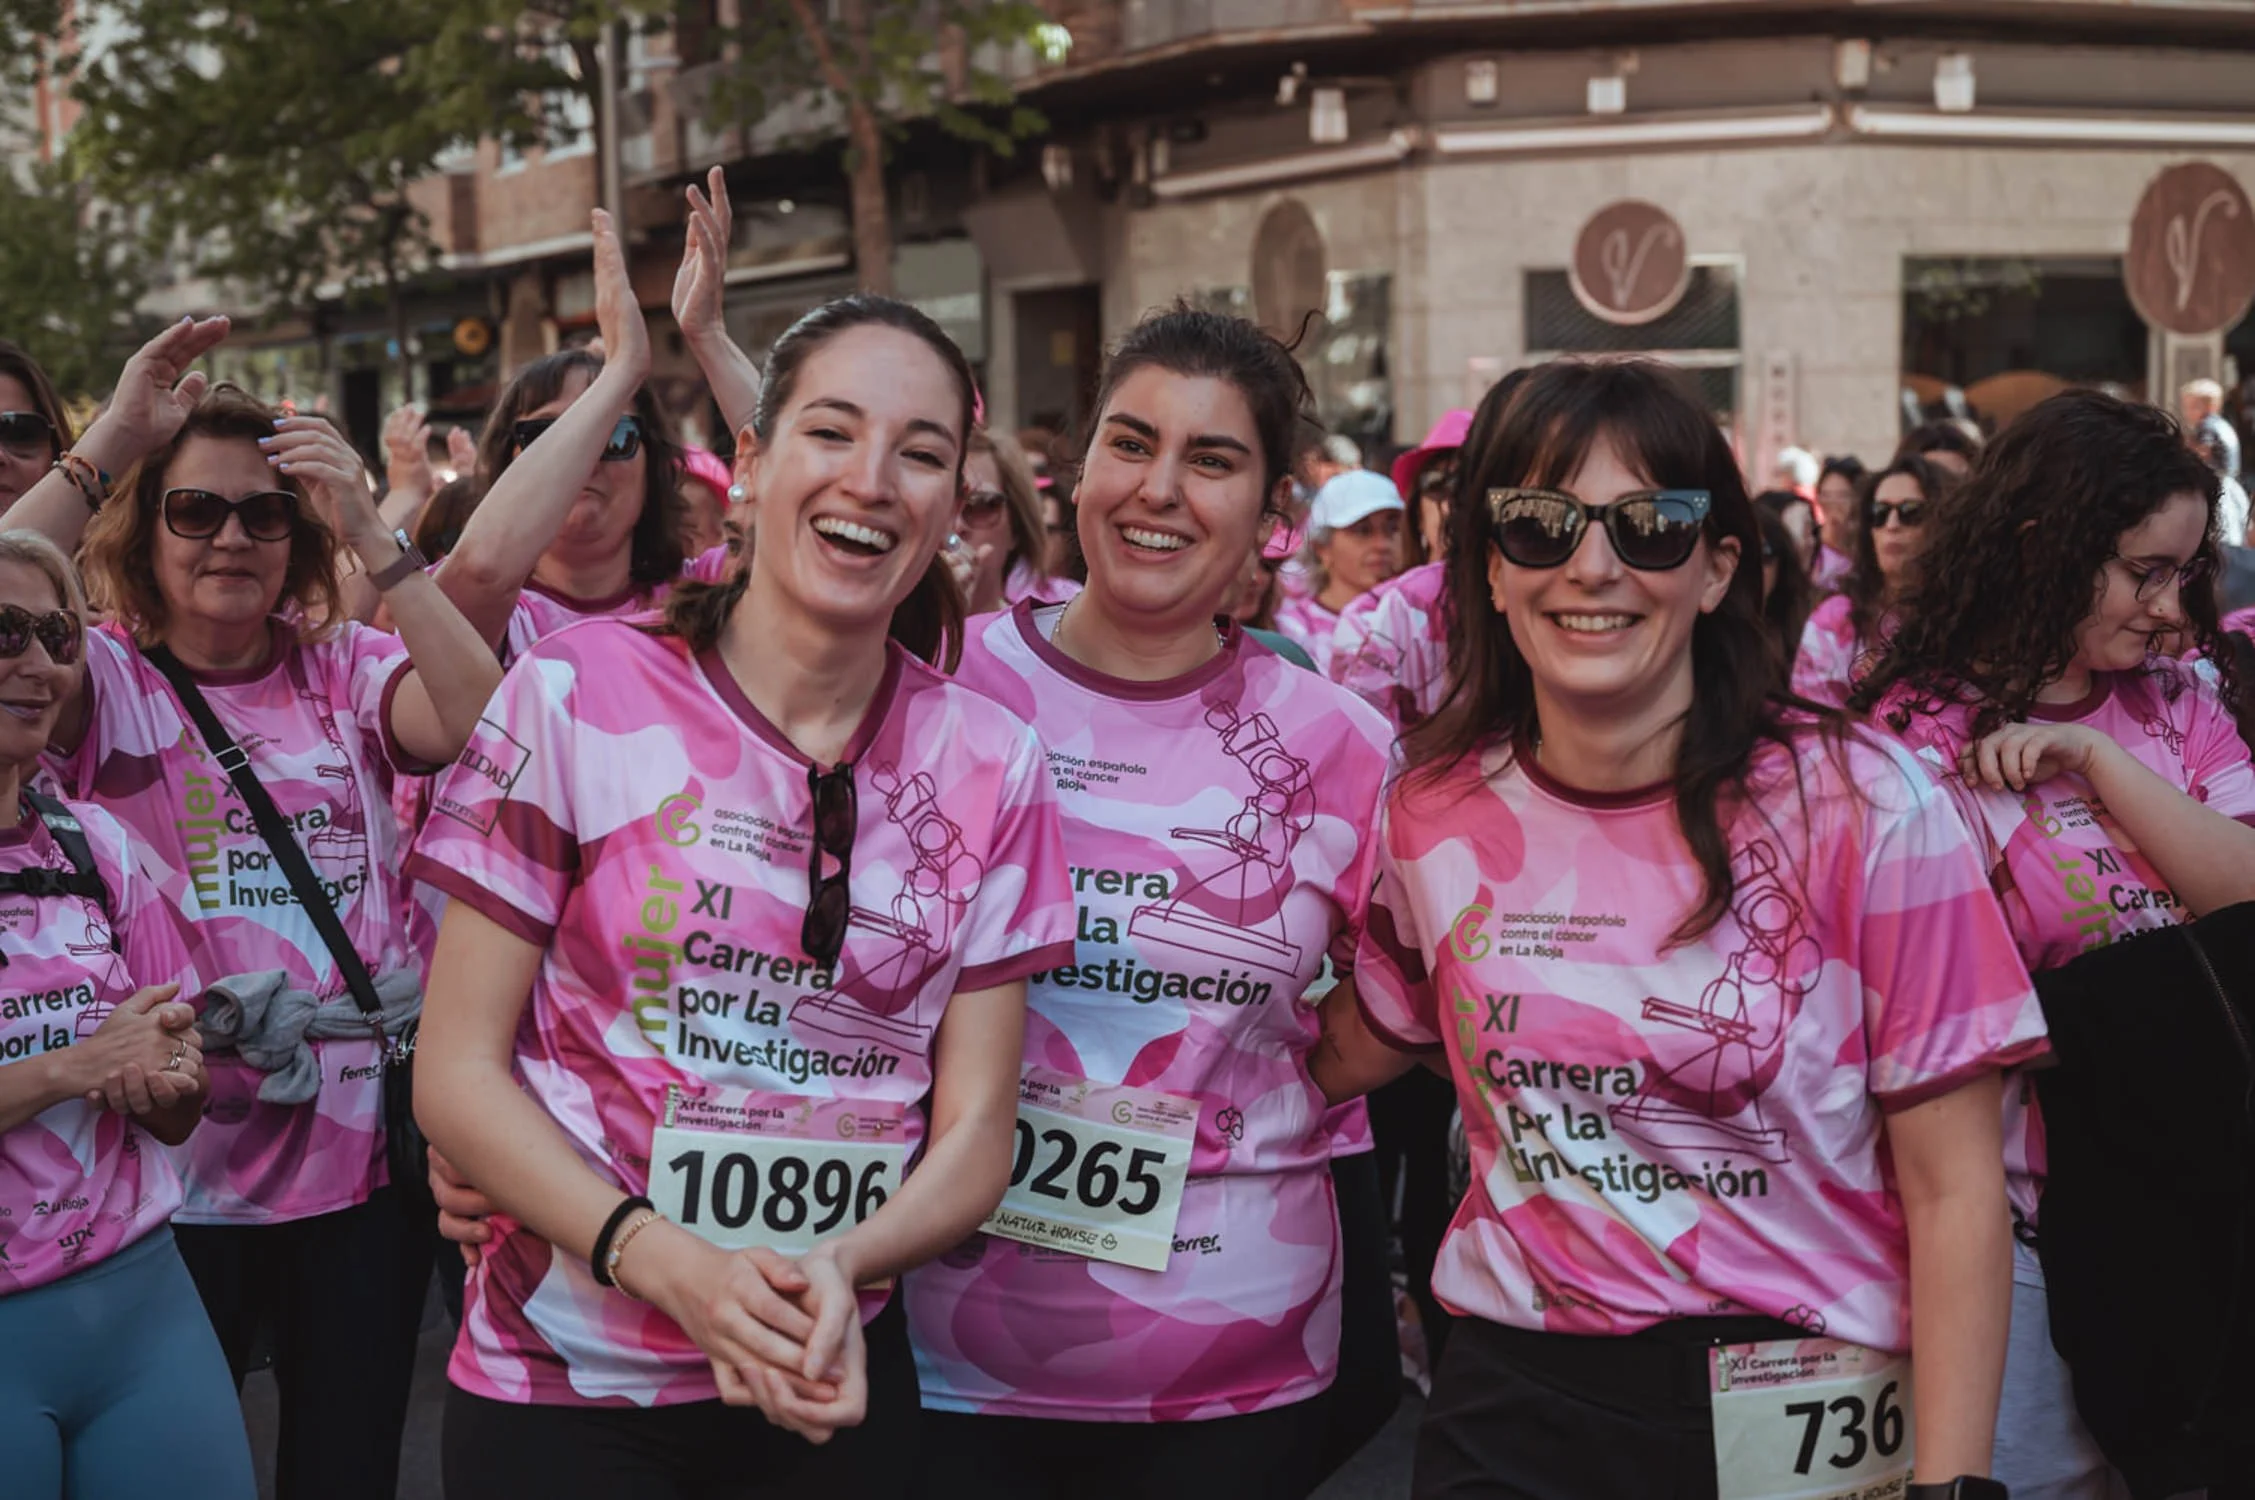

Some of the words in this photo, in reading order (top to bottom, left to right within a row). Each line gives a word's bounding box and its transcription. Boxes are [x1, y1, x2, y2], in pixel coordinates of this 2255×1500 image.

[1089, 759, 1147, 775] española
[1056, 779, 1087, 792] Rioja
[709, 837, 726, 848] en
[728, 839, 743, 852] La
[711, 822, 751, 839] contra
[227, 849, 272, 876] por
[2084, 847, 2121, 876] XI
[690, 879, 733, 921] XI
[1077, 906, 1119, 945] la
[1501, 927, 1539, 941] contra
[1541, 930, 1553, 941] el
[1555, 931, 1598, 943] cáncer
[1503, 911, 1566, 925] asociación
[1569, 913, 1627, 928] española
[622, 865, 684, 1057] mujer
[683, 931, 834, 991] Carrera
[1499, 945, 1514, 956] en
[1516, 944, 1531, 957] La
[1533, 945, 1564, 960] Rioja
[0, 983, 94, 1020] arrera
[677, 985, 740, 1018] por
[743, 989, 781, 1026] la
[1482, 994, 1521, 1033] XI
[43, 1023, 70, 1052] la
[677, 1021, 900, 1084] Investigación
[1484, 1049, 1636, 1097] Carrera
[698, 1101, 747, 1116] Carrera
[748, 1108, 770, 1119] por
[771, 1107, 785, 1120] la
[1562, 1103, 1606, 1141] la
[669, 1150, 888, 1235] 10896
[997, 1212, 1047, 1235] NATUR
[1050, 1223, 1098, 1246] HOUSE
[1750, 1355, 1798, 1370] Carrera
[1800, 1354, 1821, 1365] por
[1785, 1381, 1904, 1475] 736
